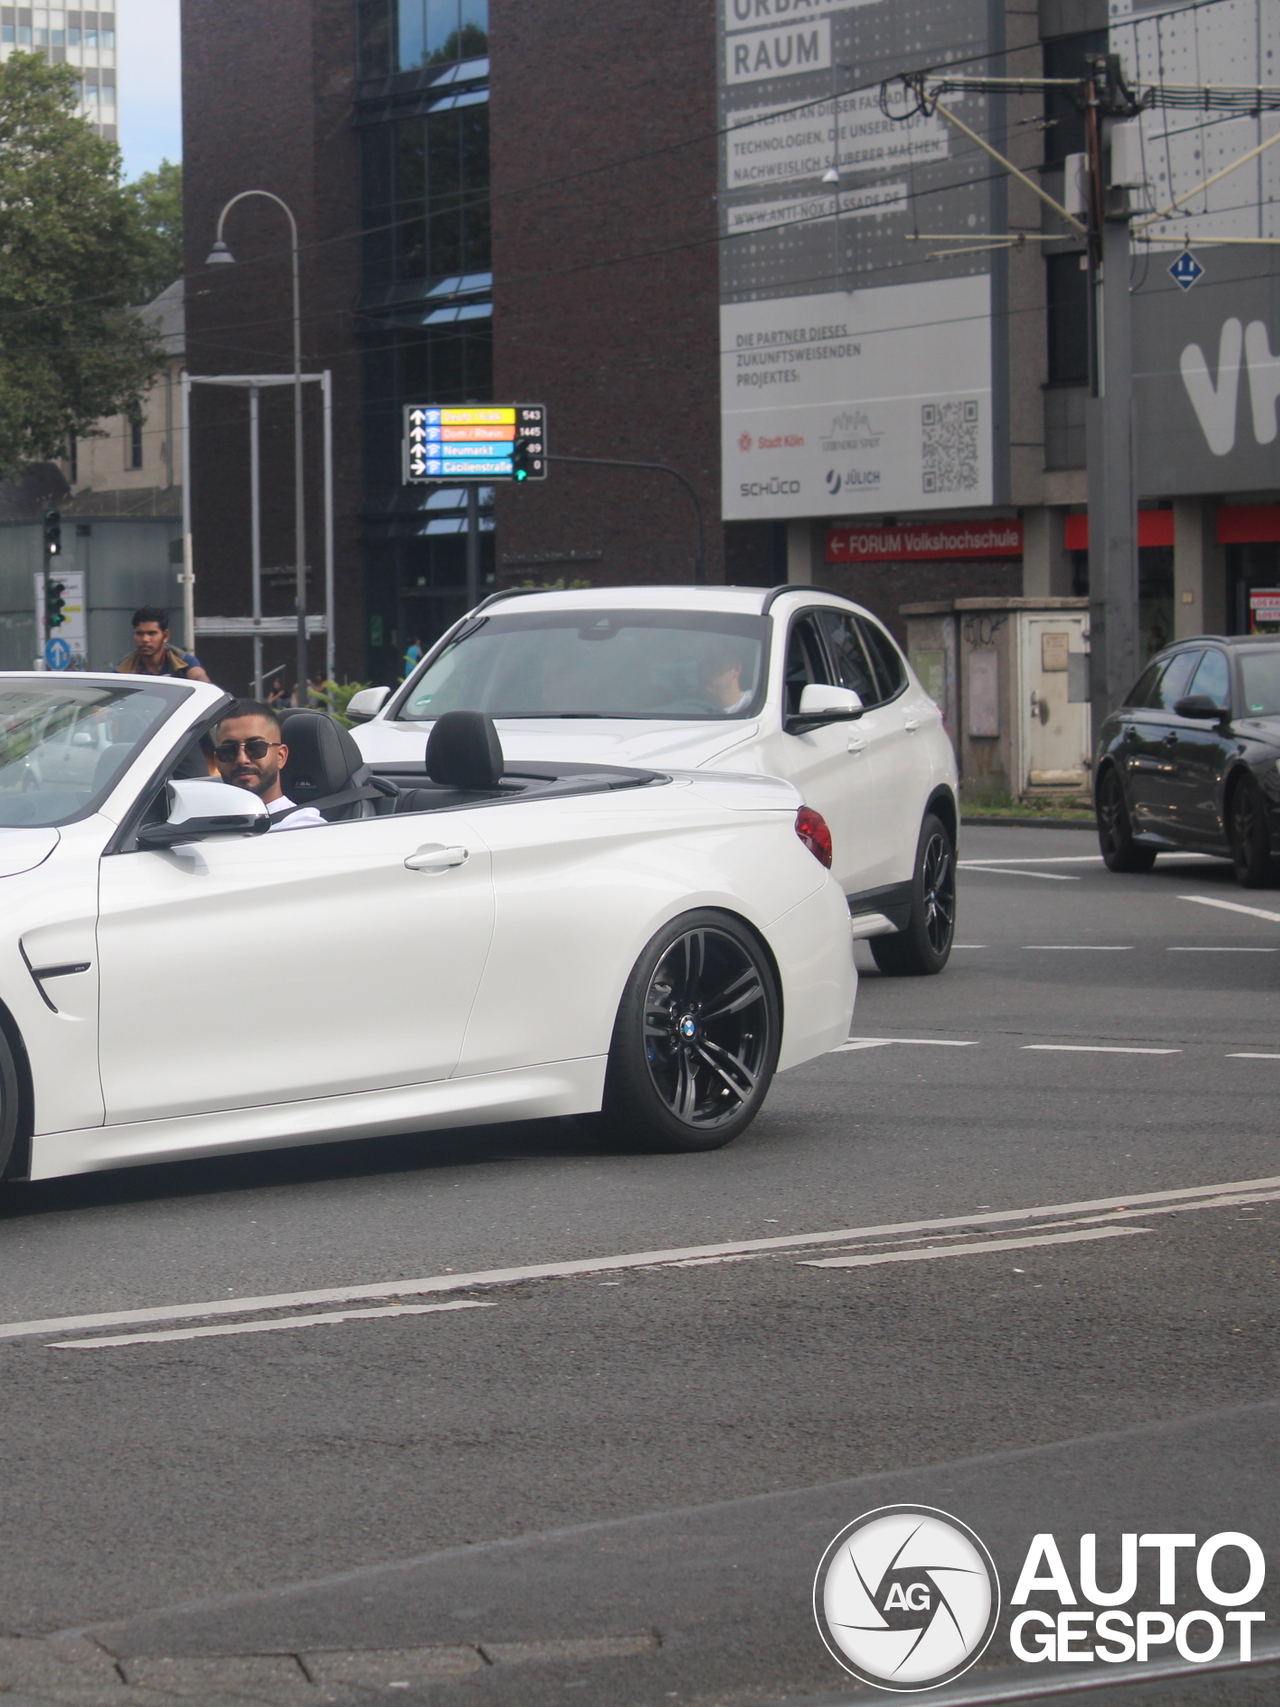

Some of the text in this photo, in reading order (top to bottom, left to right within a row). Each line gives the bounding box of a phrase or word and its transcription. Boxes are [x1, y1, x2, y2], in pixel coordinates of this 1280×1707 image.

[734, 30, 819, 75] RAUM
[850, 120, 896, 138] UNSERE
[734, 159, 820, 180] NACHWEISLICH
[736, 324, 847, 347] DIE PARTNER DIESES
[736, 343, 861, 367] ZUKUNFTSWEISENDEN
[522, 410, 541, 420] 543
[520, 427, 541, 436] 1445
[758, 433, 804, 449] Stadt Köln
[444, 446, 494, 455] Neumarkt
[533, 460, 541, 470] 0
[844, 468, 881, 485] JÜLICH
[740, 476, 800, 496] SCHÜCO
[849, 528, 1019, 554] FORUM Volkshochschule
